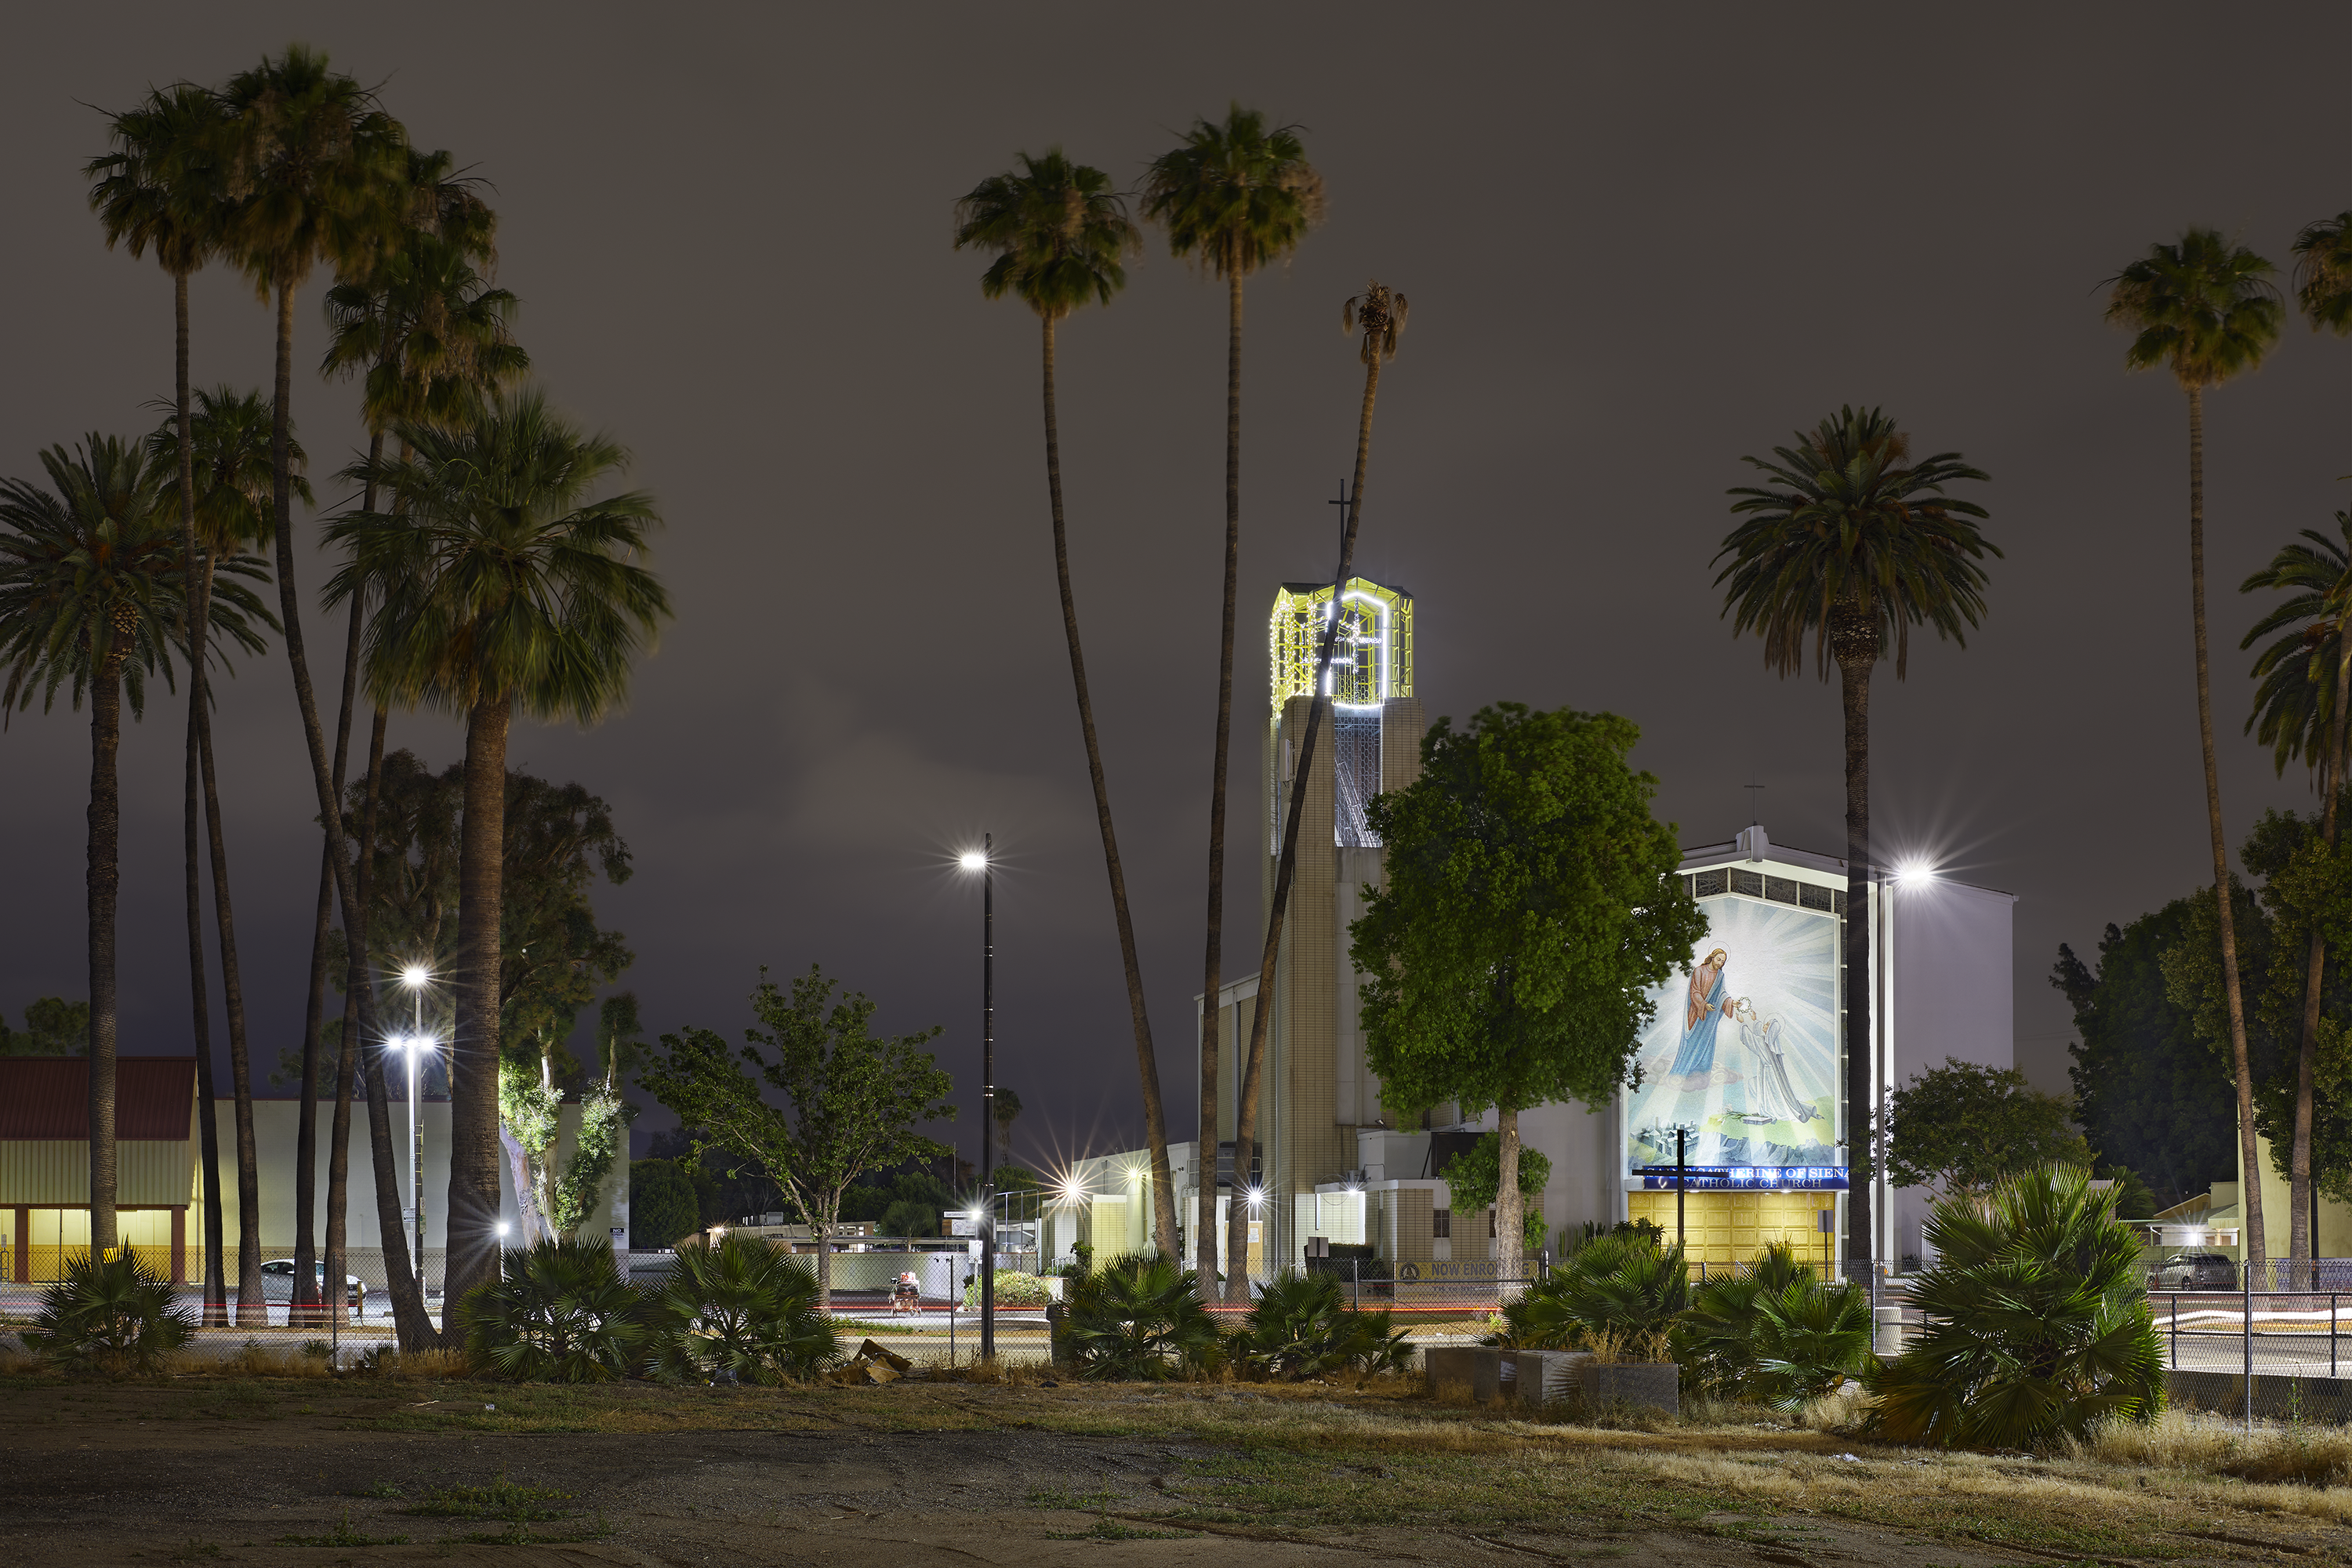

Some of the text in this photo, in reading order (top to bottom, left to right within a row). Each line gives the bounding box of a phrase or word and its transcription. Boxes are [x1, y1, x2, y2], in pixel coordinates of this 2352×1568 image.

[1785, 1168, 1806, 1178] OF
[1759, 1178, 1822, 1188] CHURCH
[1432, 1263, 1459, 1276] NOW
[1463, 1263, 1529, 1276] ENROG
